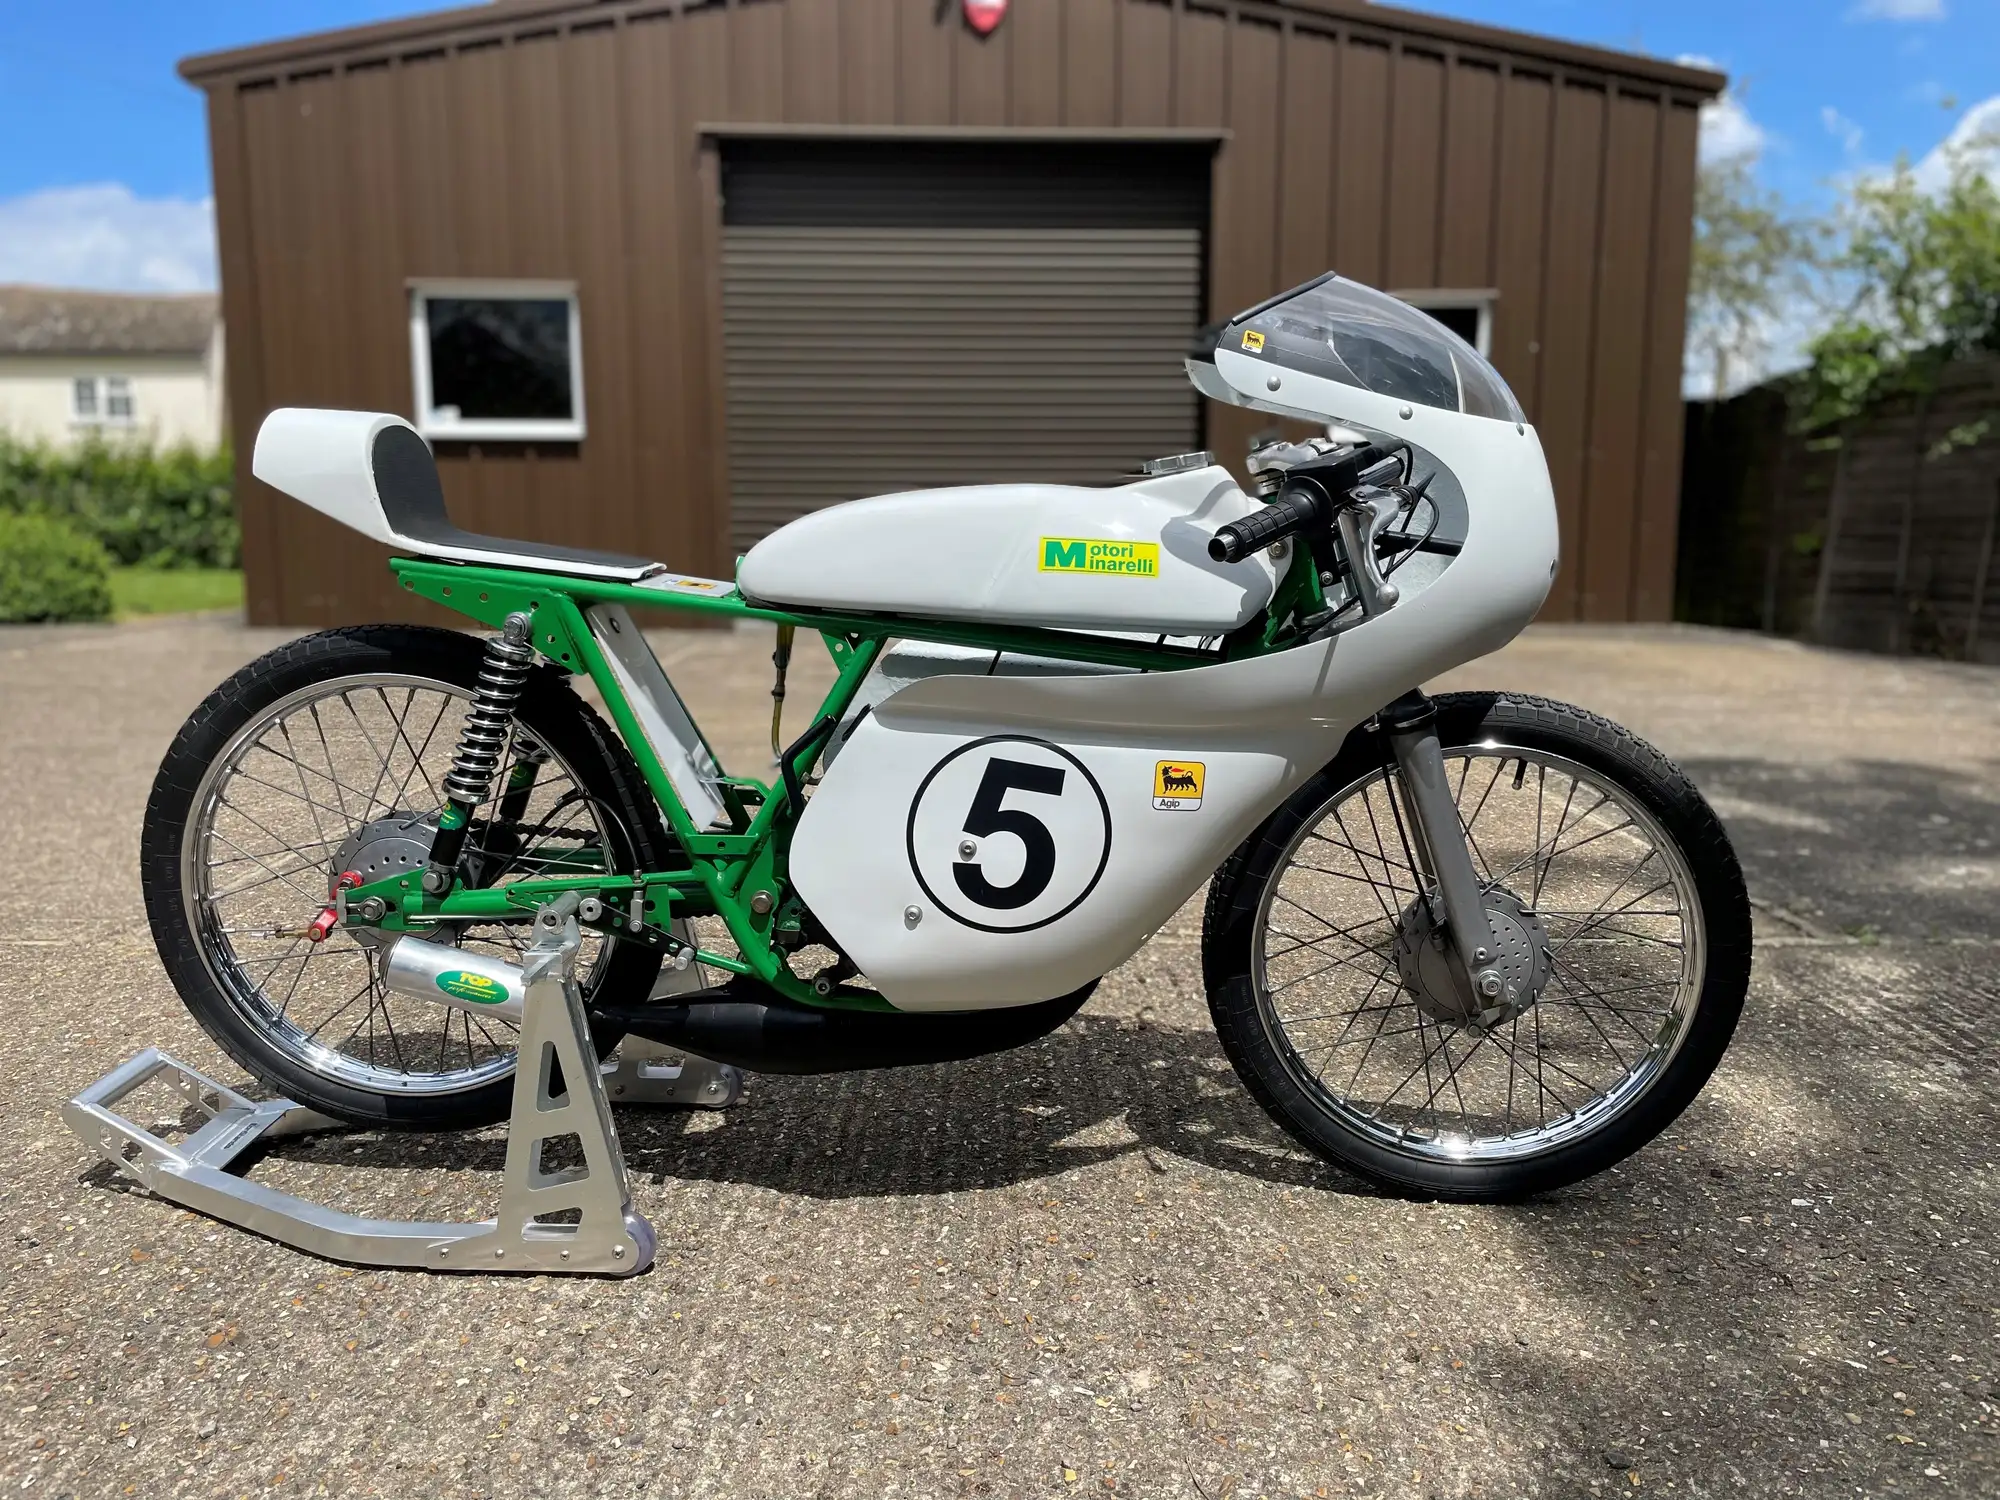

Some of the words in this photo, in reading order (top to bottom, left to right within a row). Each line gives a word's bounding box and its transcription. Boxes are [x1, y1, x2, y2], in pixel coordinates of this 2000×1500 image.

[1159, 799, 1180, 808] Agip
[952, 757, 1065, 910] 5
[459, 972, 492, 987] TOP
